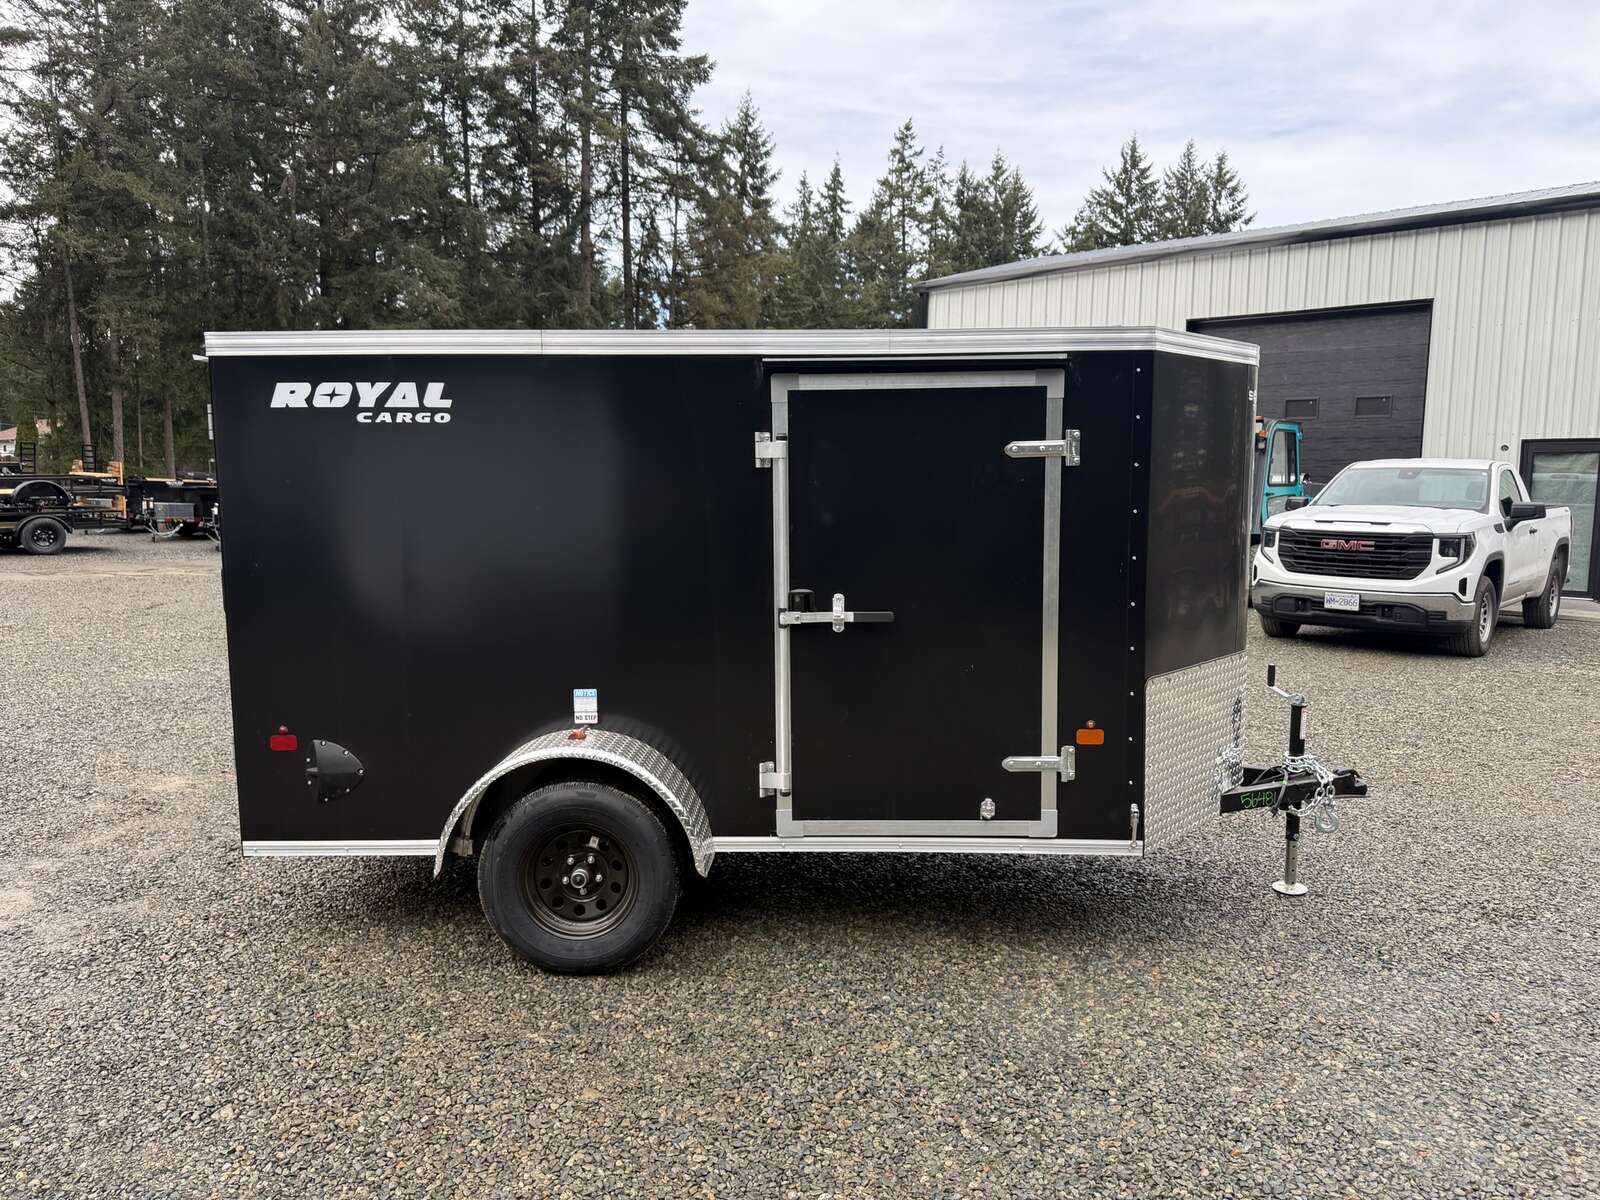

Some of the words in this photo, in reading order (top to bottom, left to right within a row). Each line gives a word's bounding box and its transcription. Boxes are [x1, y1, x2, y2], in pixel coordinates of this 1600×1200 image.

[270, 382, 453, 408] ROYAL
[356, 412, 452, 423] CARGO
[1320, 539, 1376, 551] GMC
